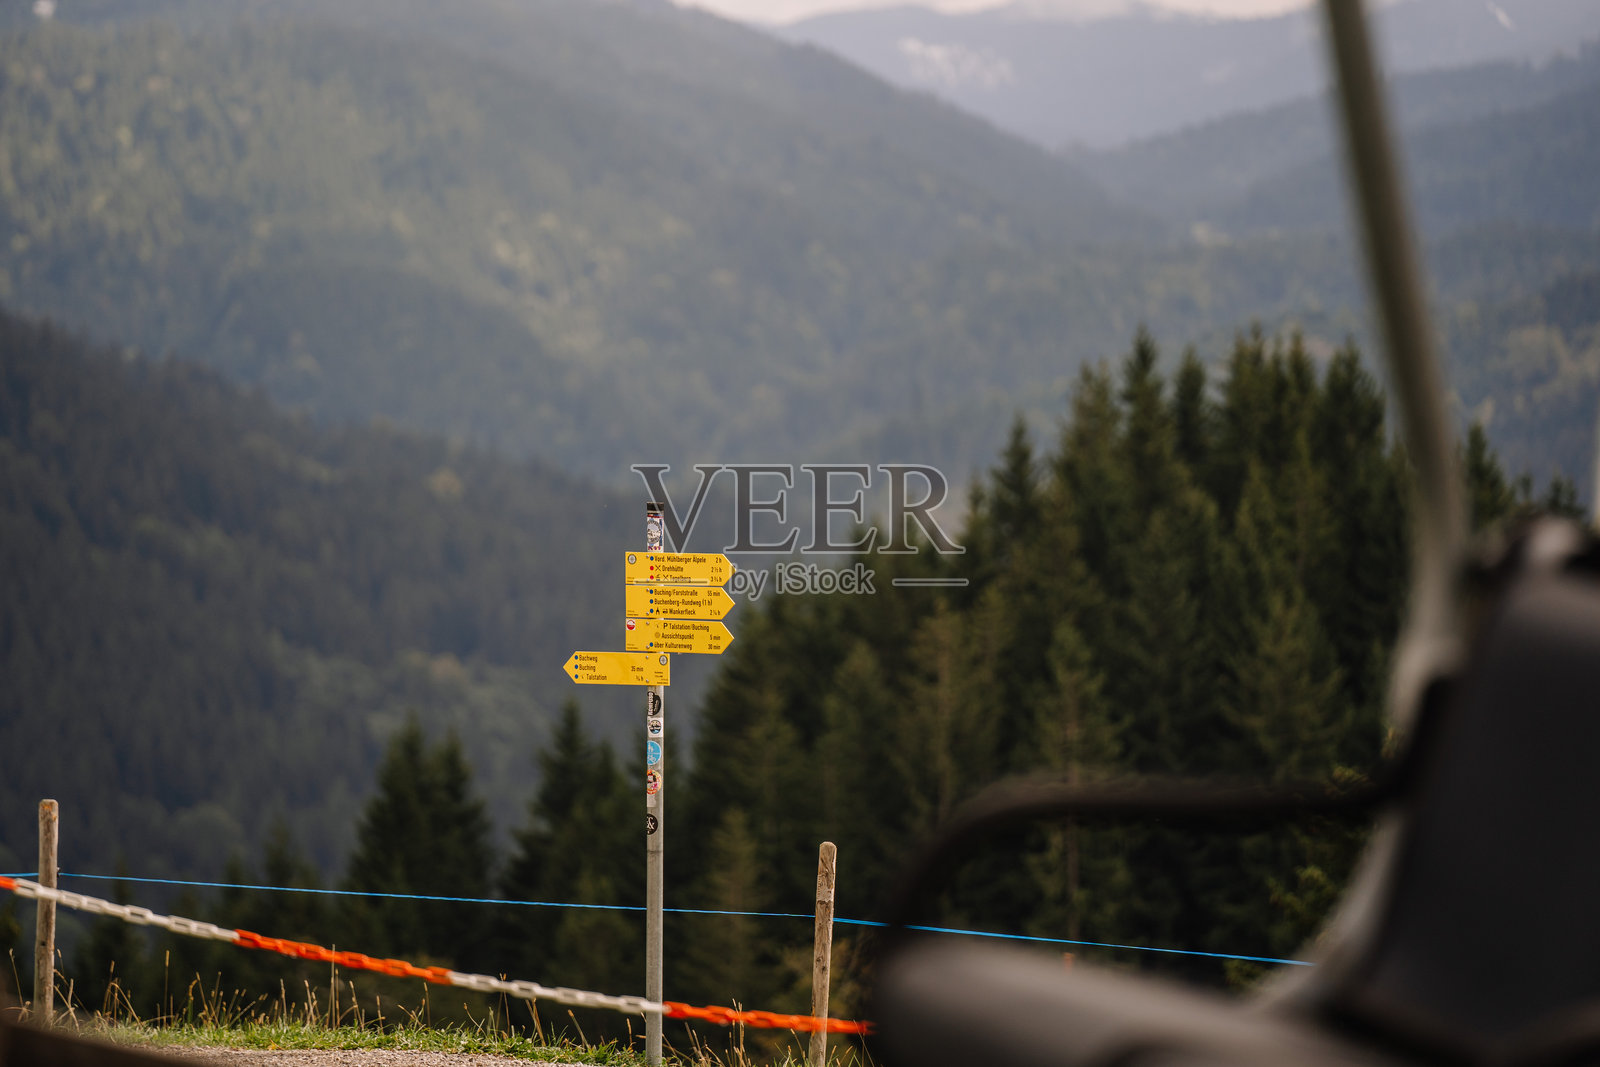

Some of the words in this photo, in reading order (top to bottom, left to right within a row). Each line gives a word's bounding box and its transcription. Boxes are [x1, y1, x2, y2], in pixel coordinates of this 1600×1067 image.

[666, 556, 692, 564] Mühlberger
[670, 574, 691, 583] Tegelberg
[654, 598, 701, 607] Buchenberg-Rundweg
[579, 664, 596, 672] Buching
